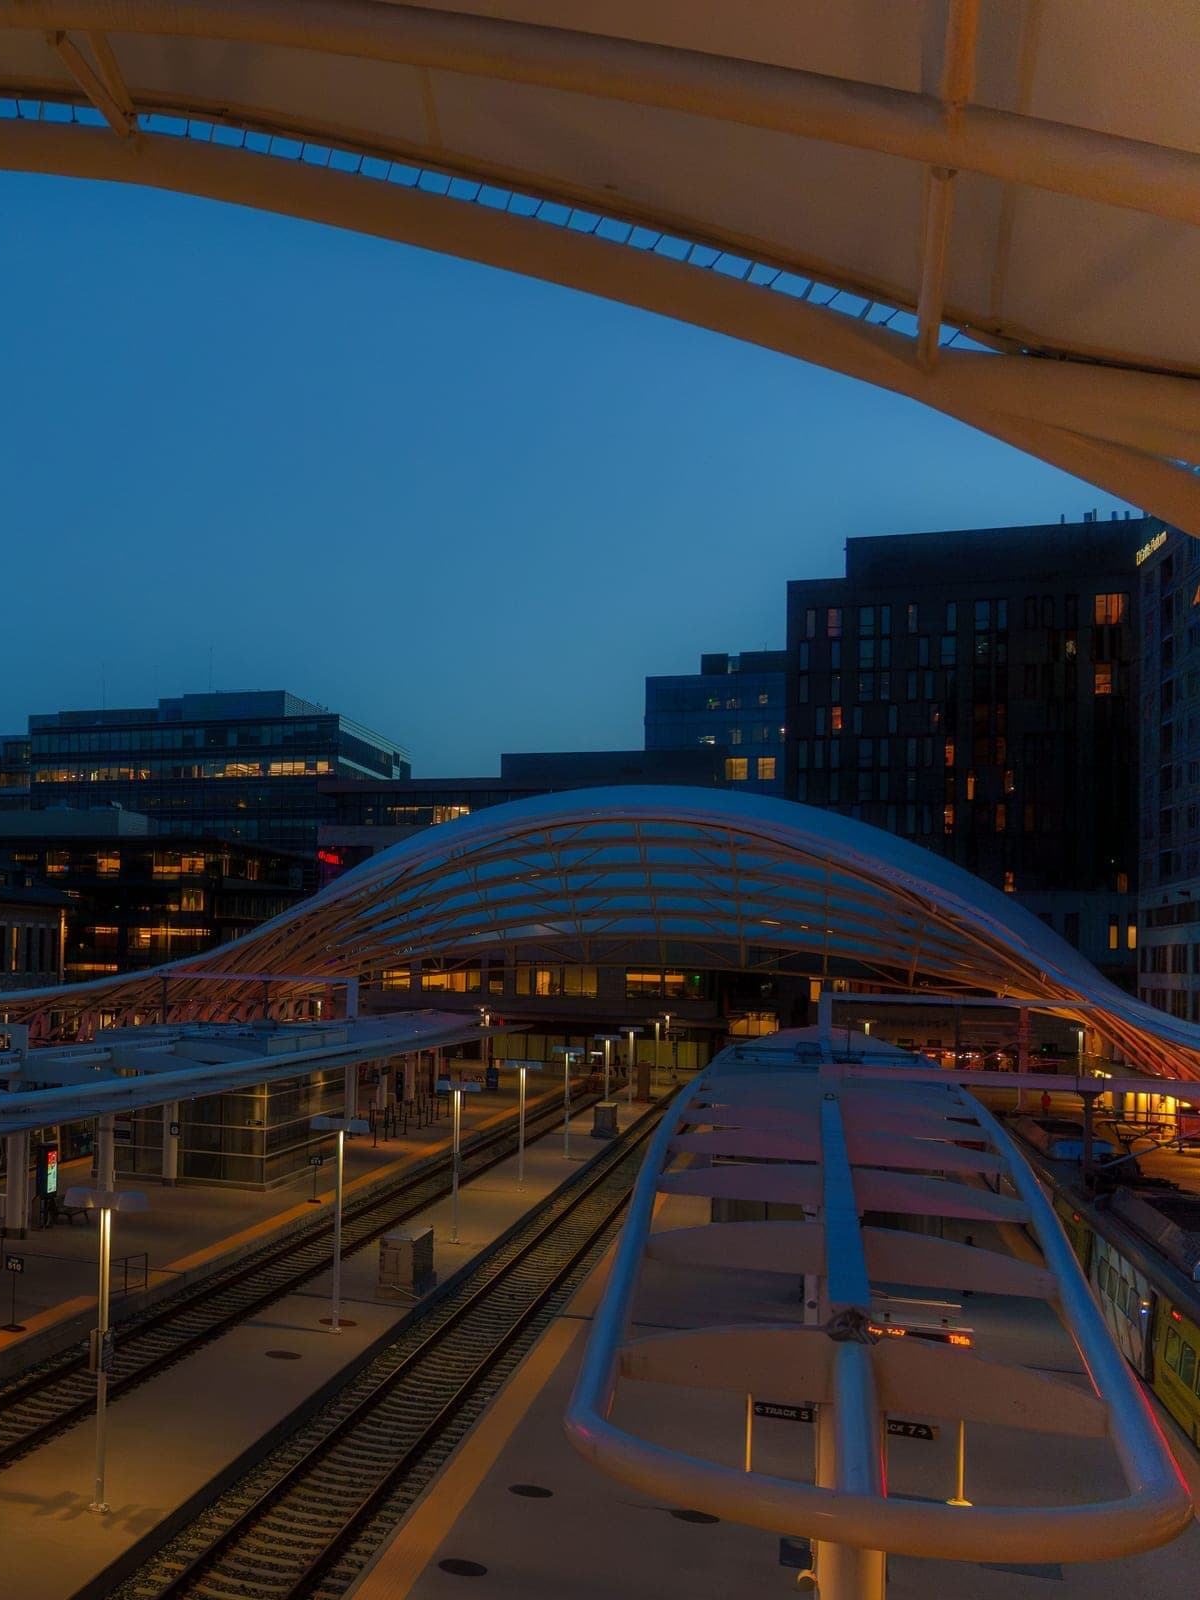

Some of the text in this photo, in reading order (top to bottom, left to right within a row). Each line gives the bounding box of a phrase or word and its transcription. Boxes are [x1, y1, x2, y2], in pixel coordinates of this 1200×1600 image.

[764, 1406, 809, 1420] TRACK 5
[908, 1425, 917, 1435] 7
